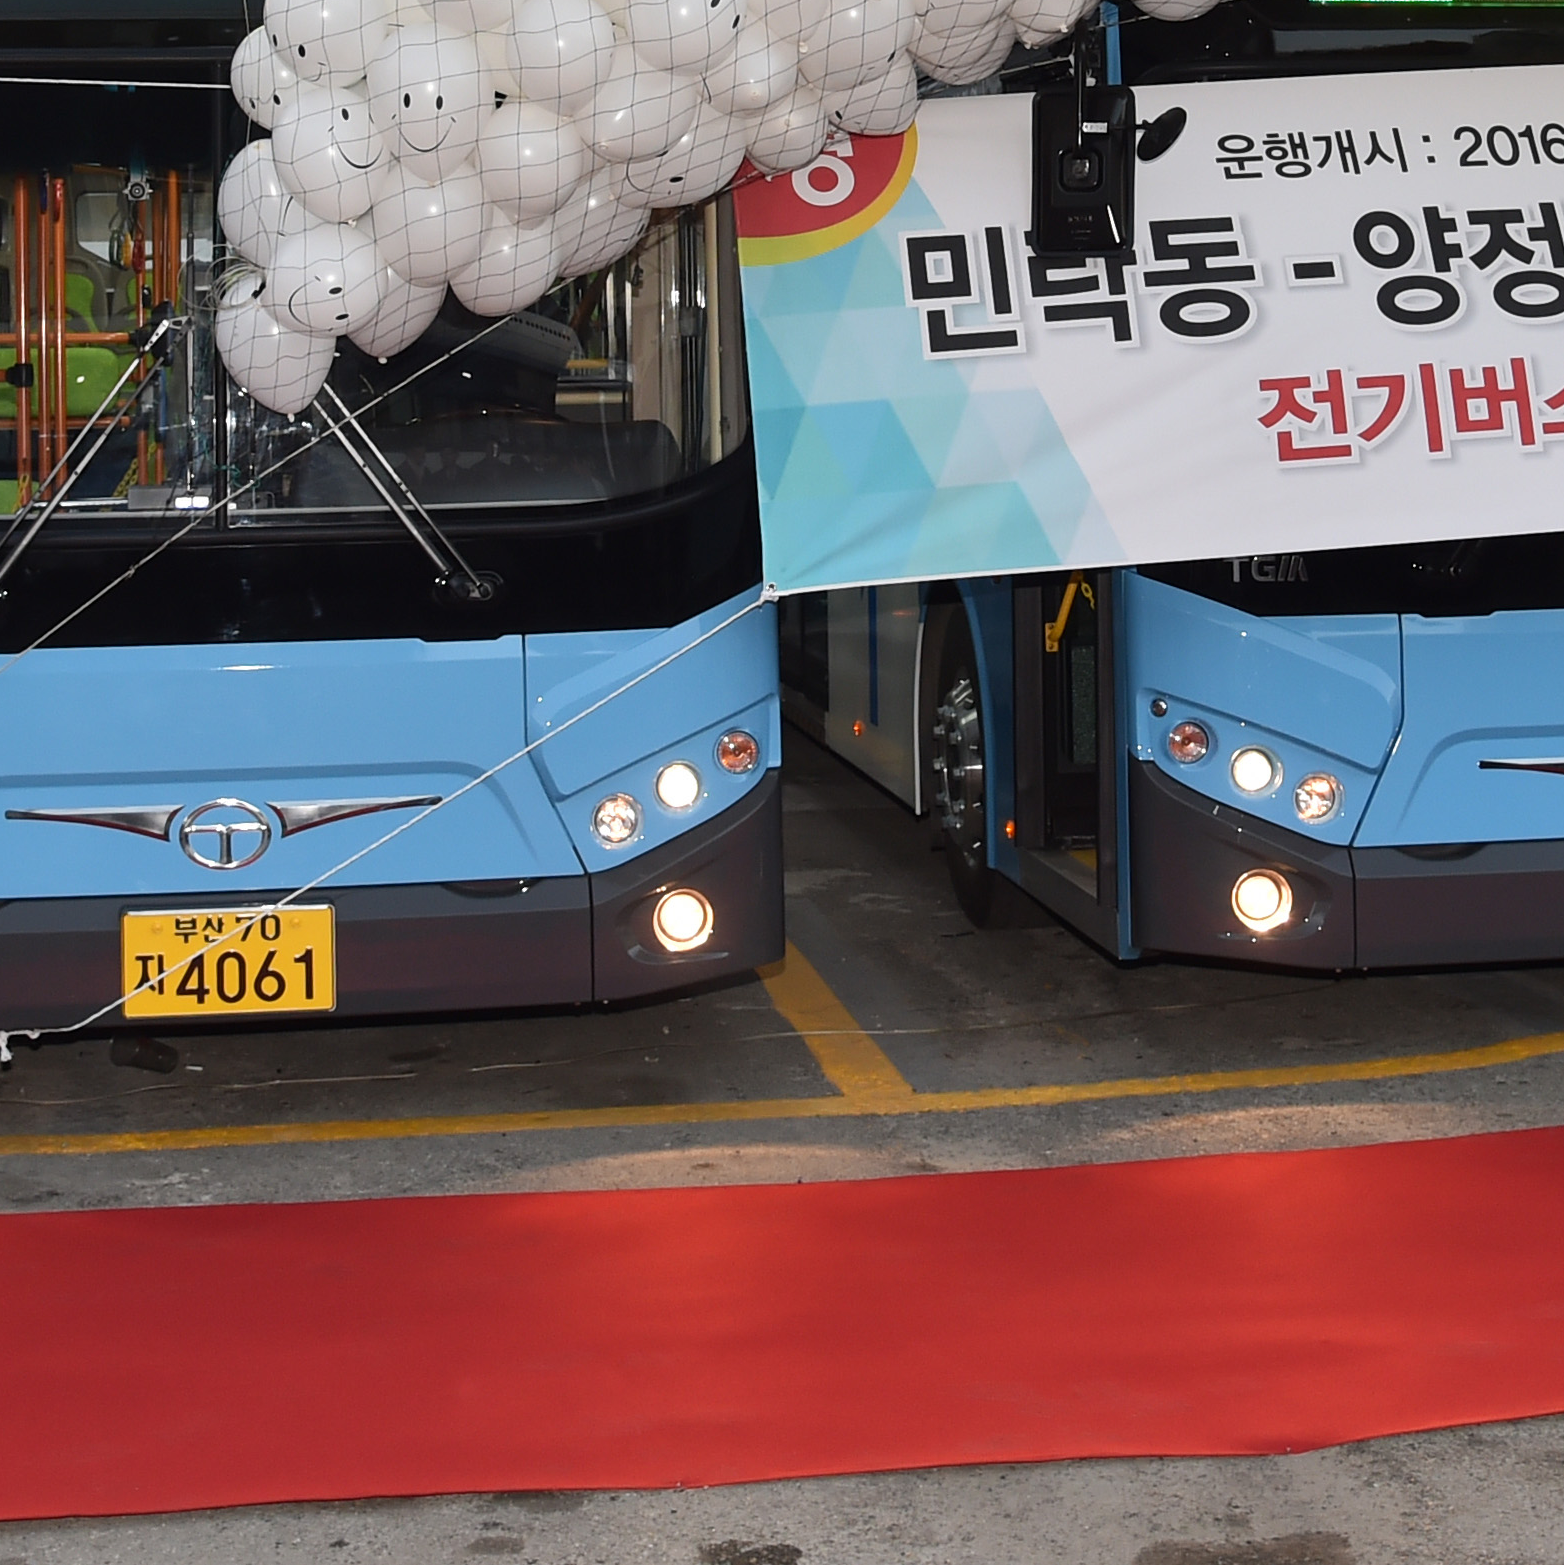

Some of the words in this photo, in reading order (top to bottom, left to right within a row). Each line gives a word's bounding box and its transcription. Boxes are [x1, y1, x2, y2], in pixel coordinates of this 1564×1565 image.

[1214, 126, 1410, 181] 운행개시
[173, 914, 225, 944] 부산
[235, 912, 283, 942] 70
